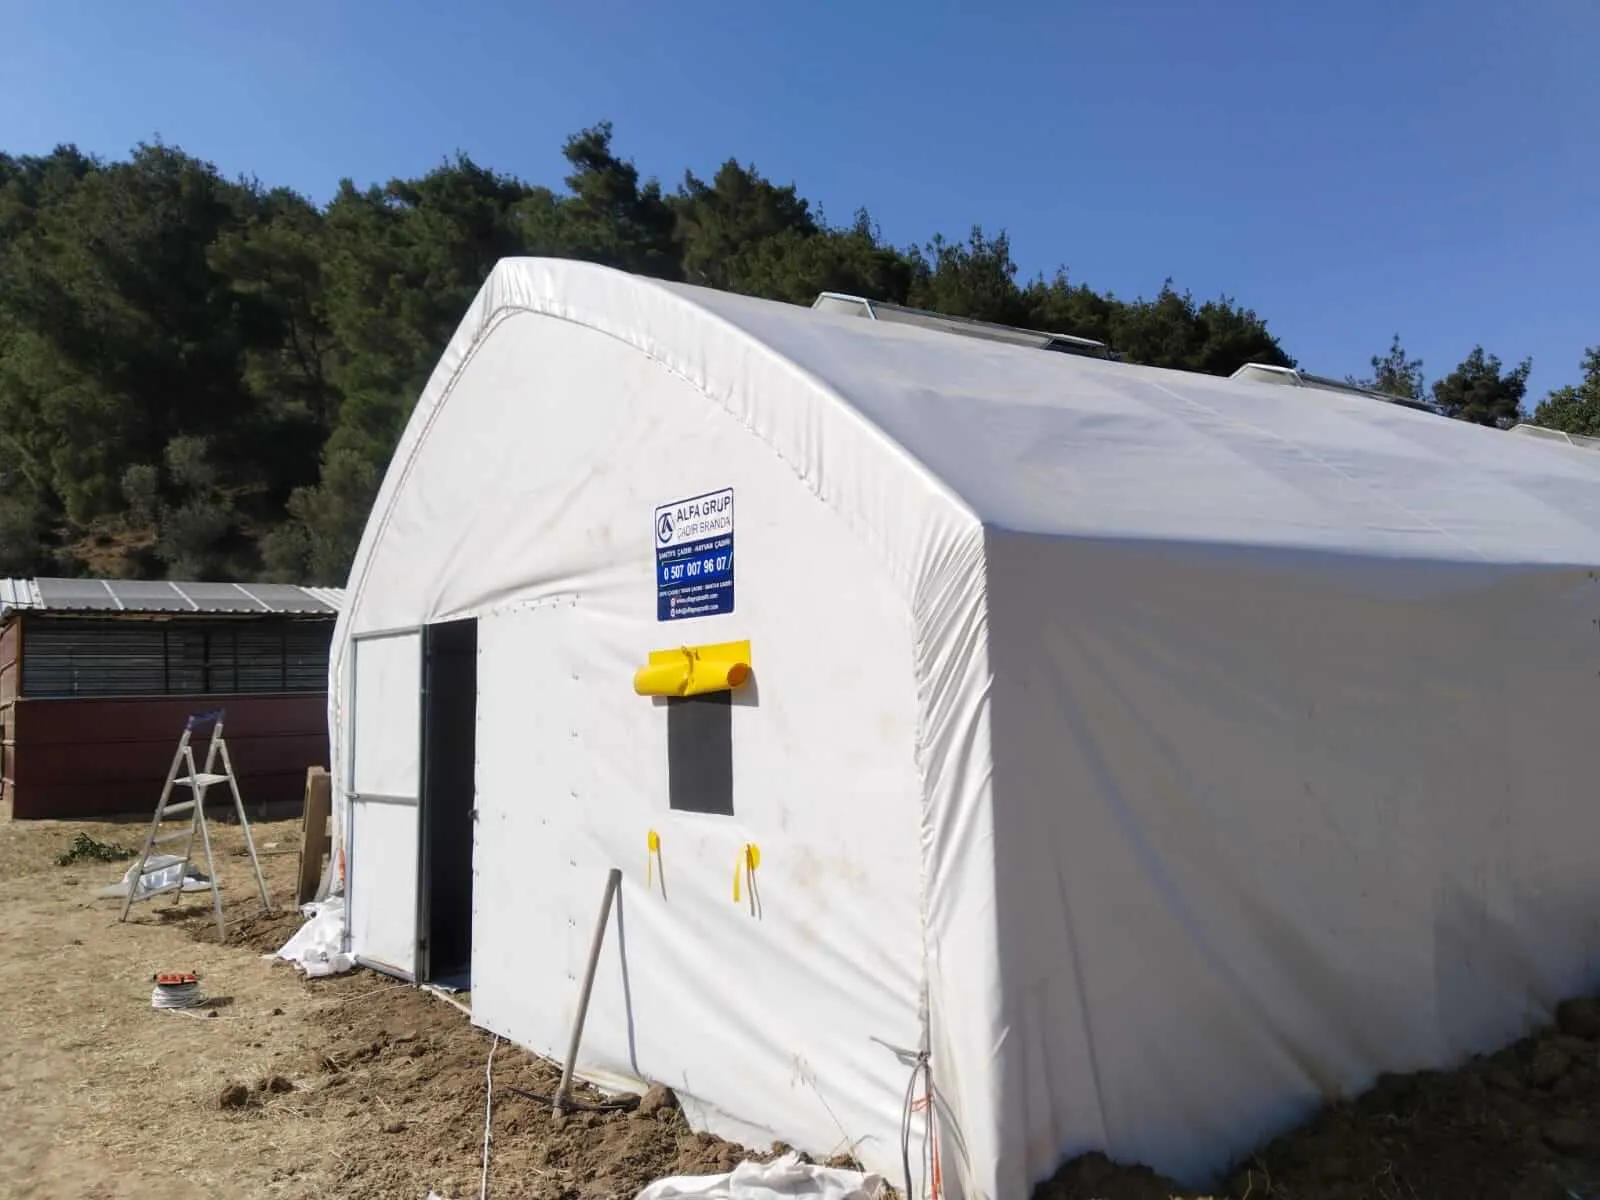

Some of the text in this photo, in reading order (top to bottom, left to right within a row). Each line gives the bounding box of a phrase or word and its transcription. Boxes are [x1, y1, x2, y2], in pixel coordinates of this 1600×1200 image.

[677, 496, 731, 522] ALFA GRUP
[700, 516, 731, 533] BRANDA
[664, 556, 727, 580] 0 507 007 96 07
